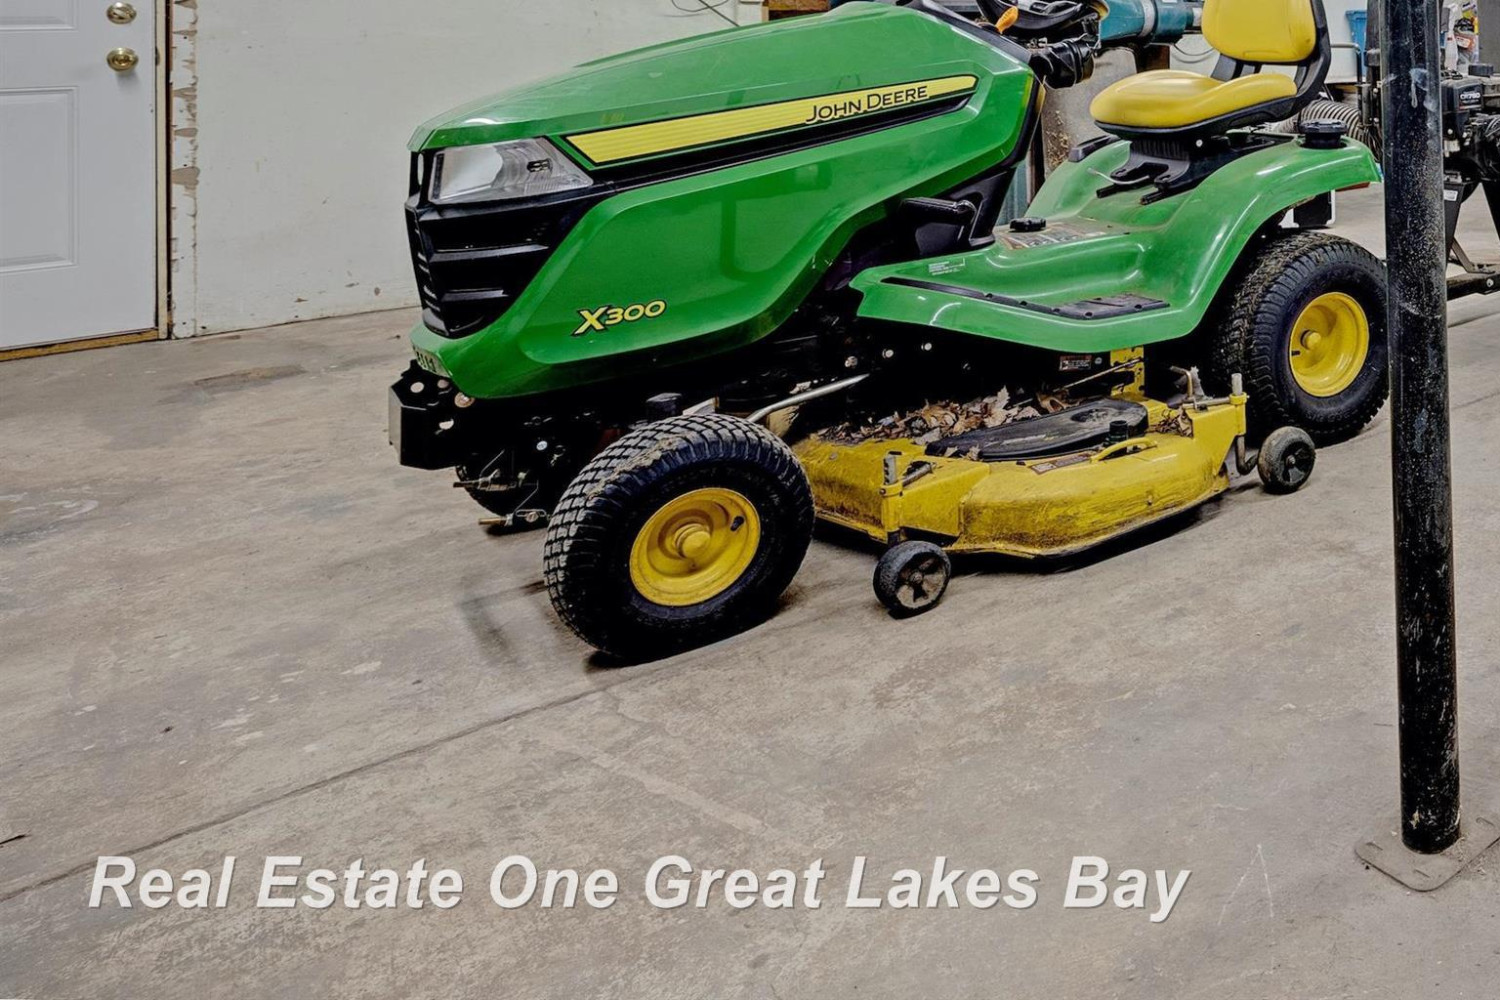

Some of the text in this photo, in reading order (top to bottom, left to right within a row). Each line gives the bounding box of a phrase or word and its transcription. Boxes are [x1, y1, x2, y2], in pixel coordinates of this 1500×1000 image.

[805, 85, 929, 122] JOHN DEERE
[570, 299, 667, 336] X300
